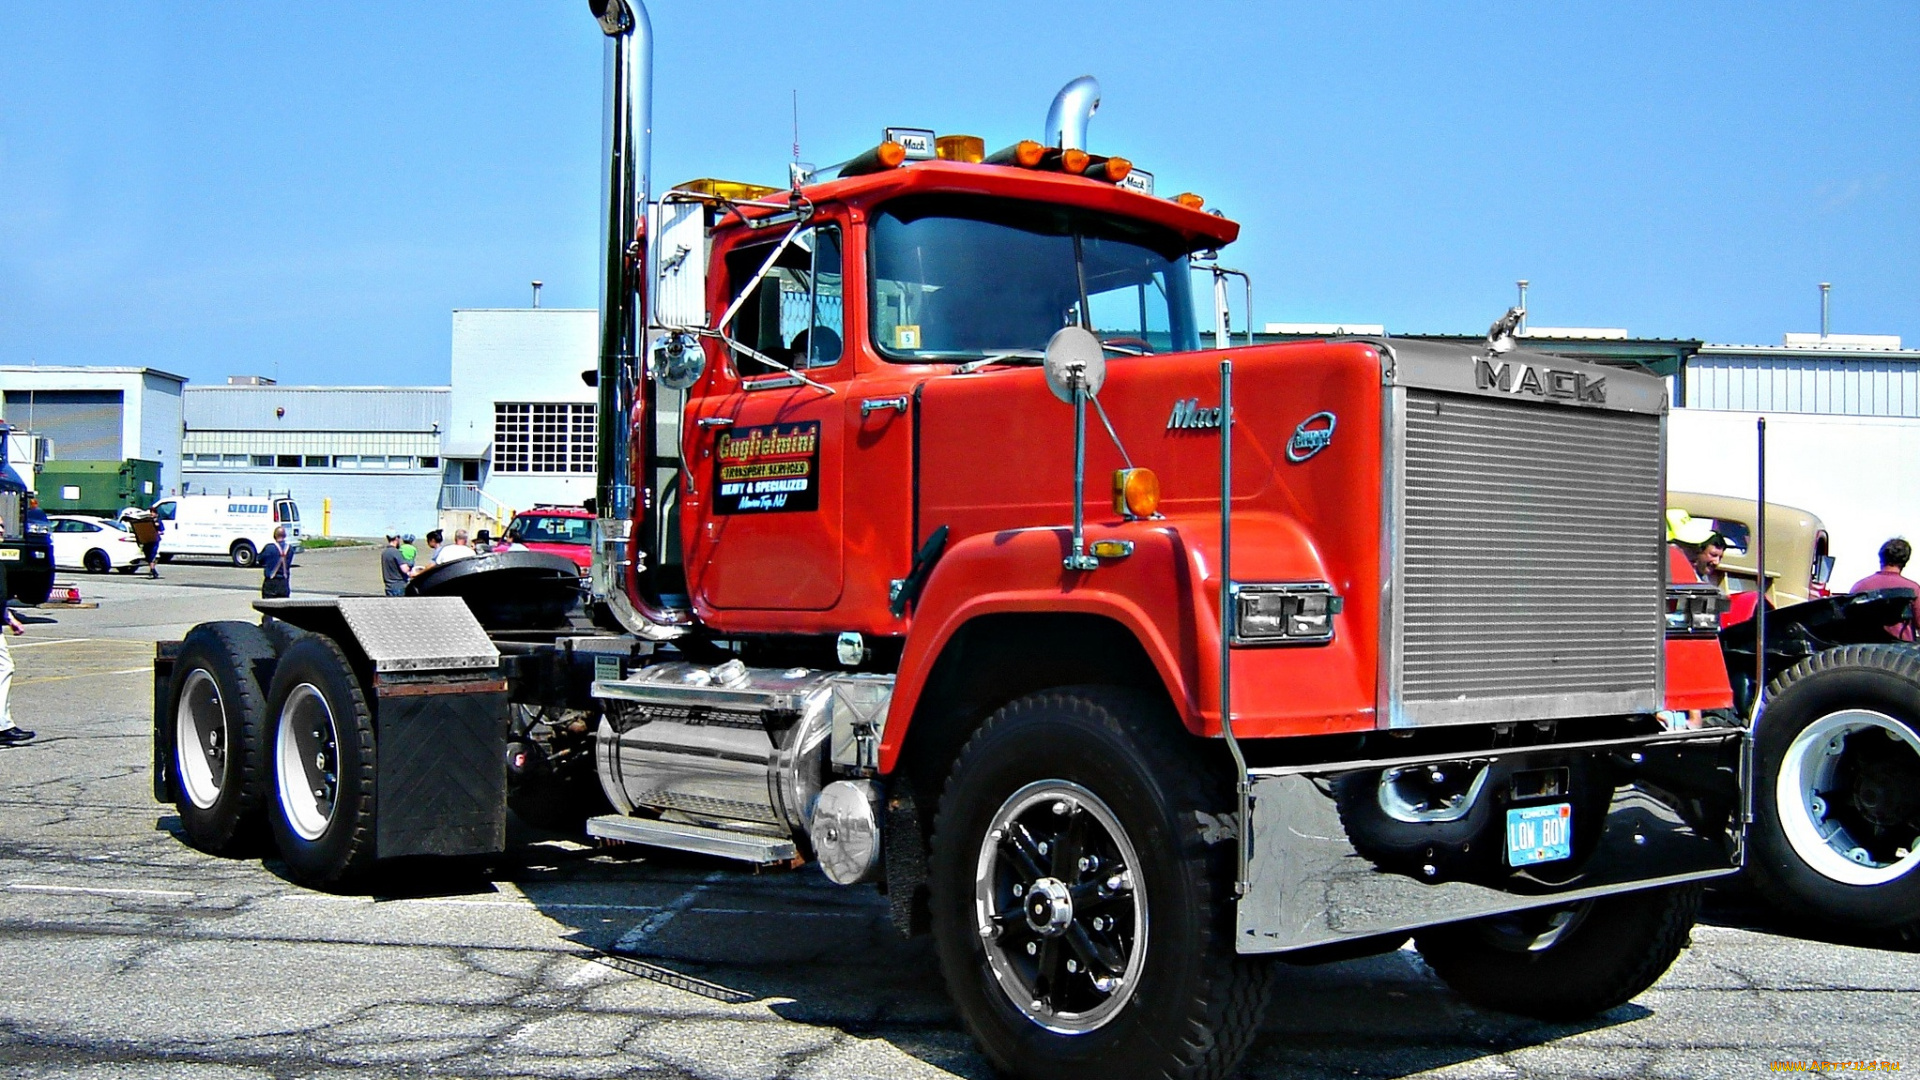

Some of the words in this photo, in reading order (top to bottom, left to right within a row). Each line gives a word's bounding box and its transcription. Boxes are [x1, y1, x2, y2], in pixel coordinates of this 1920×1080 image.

[903, 138, 926, 151] Mack
[1126, 175, 1145, 190] Mack
[1471, 355, 1607, 403] MACK
[719, 426, 816, 461] Guglielmini
[725, 465, 765, 477] TRANSPORT
[769, 462, 804, 474] SERVICES
[721, 483, 745, 495] HEAVY
[746, 482, 754, 493] &
[755, 479, 808, 492] SPECIALIZED
[1510, 822, 1535, 851] LOW
[1543, 817, 1567, 847] BOY
